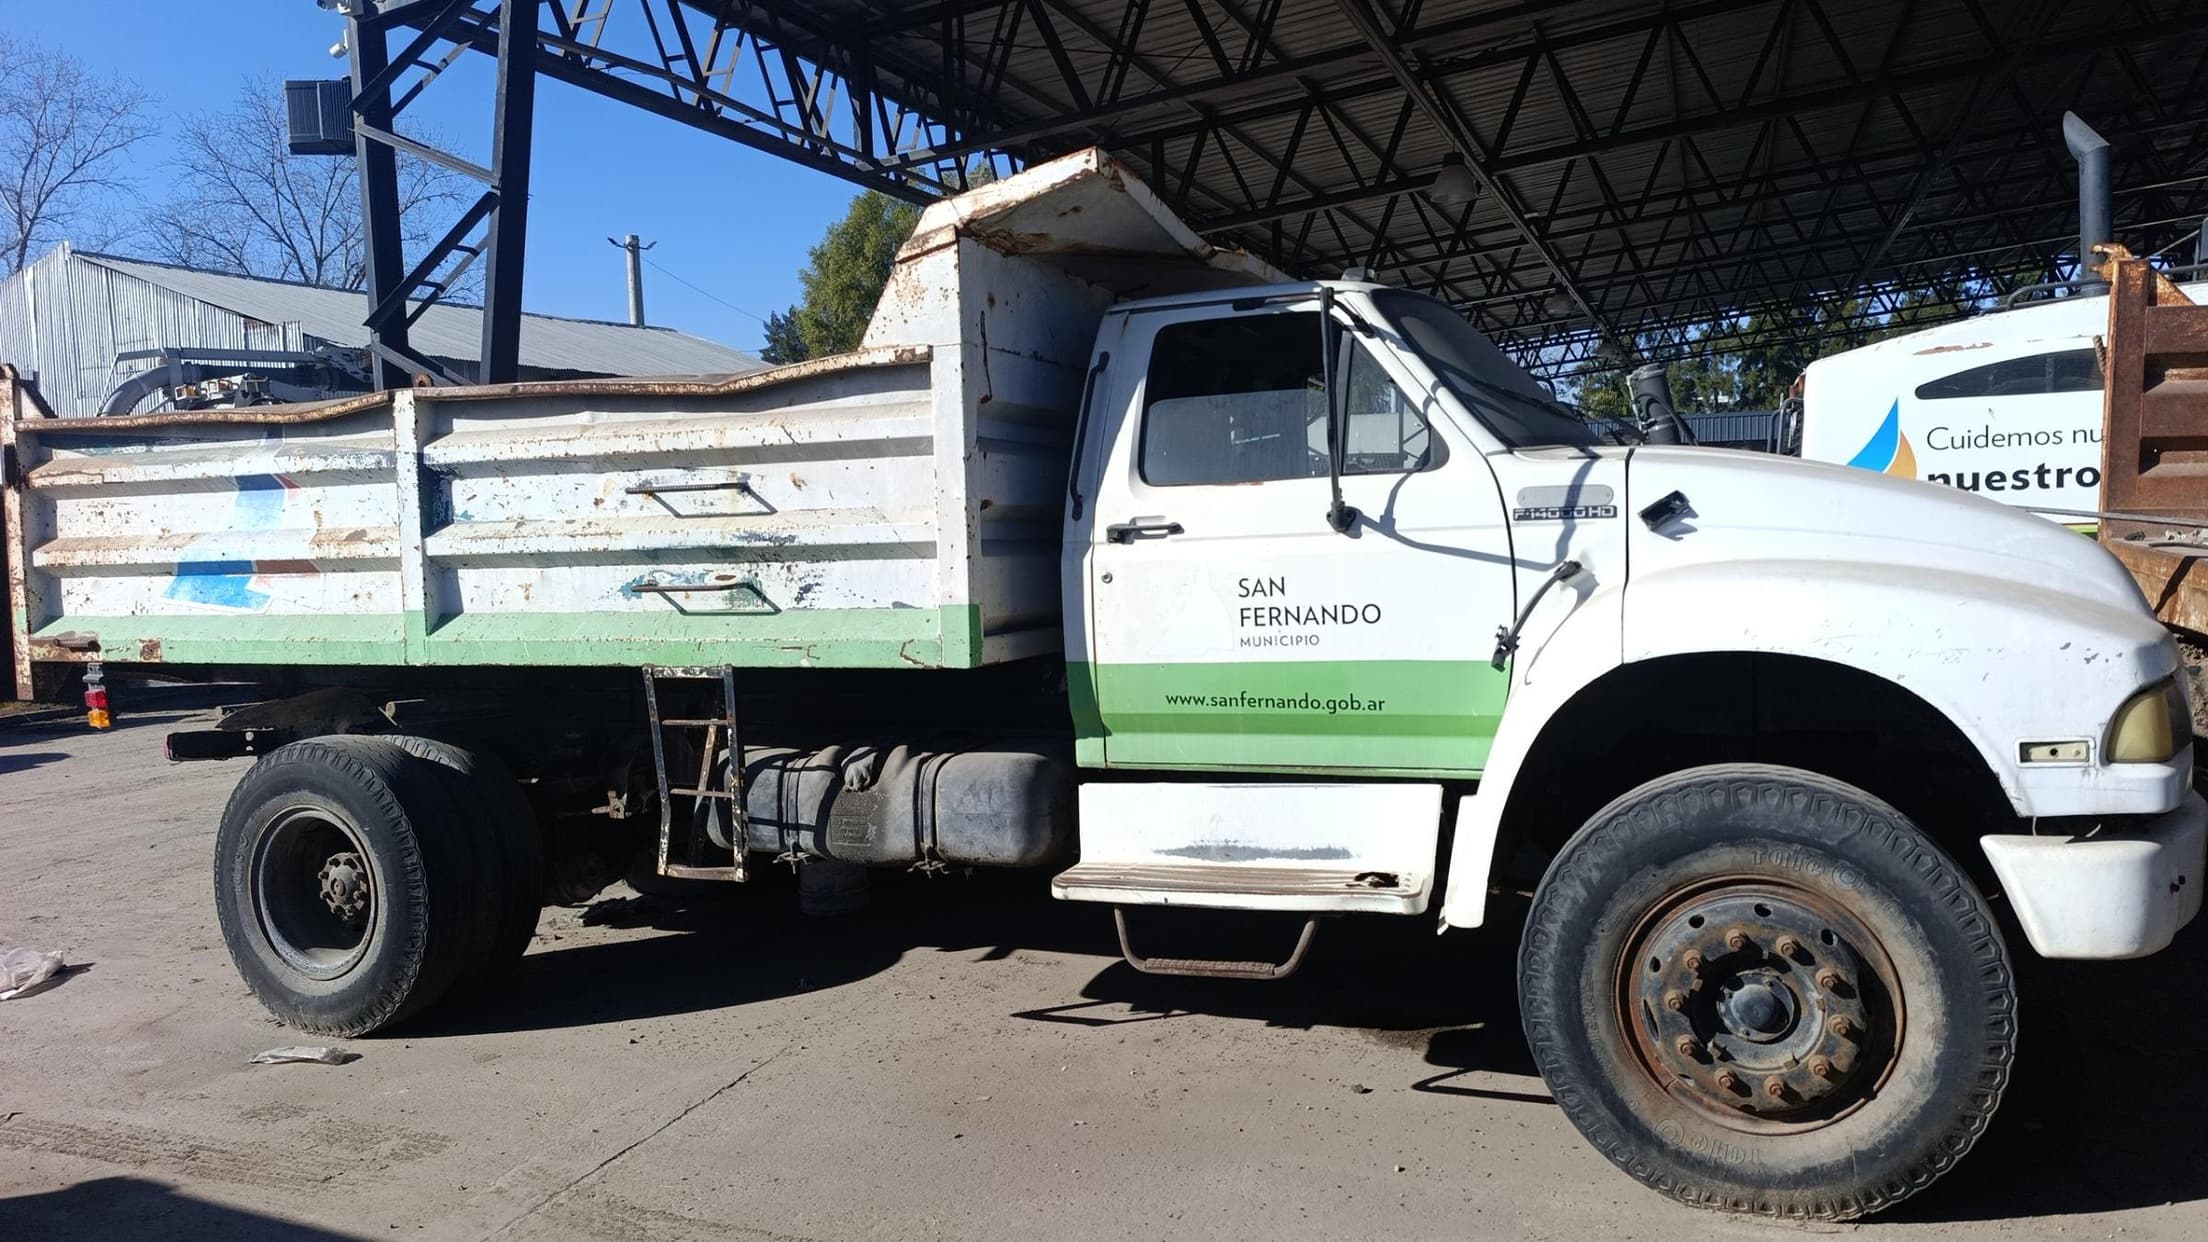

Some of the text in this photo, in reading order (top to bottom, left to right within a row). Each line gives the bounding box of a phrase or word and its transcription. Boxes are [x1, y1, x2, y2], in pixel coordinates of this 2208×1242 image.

[1927, 424, 2063, 451] Cuidemos
[1928, 462, 2101, 492] nuestro
[1238, 576, 1285, 598] SAN
[1240, 603, 1381, 627] FERNANDO
[1240, 634, 1320, 647] MUNICIPIO
[1165, 691, 1386, 715] www.sanfernando.gob.ar
